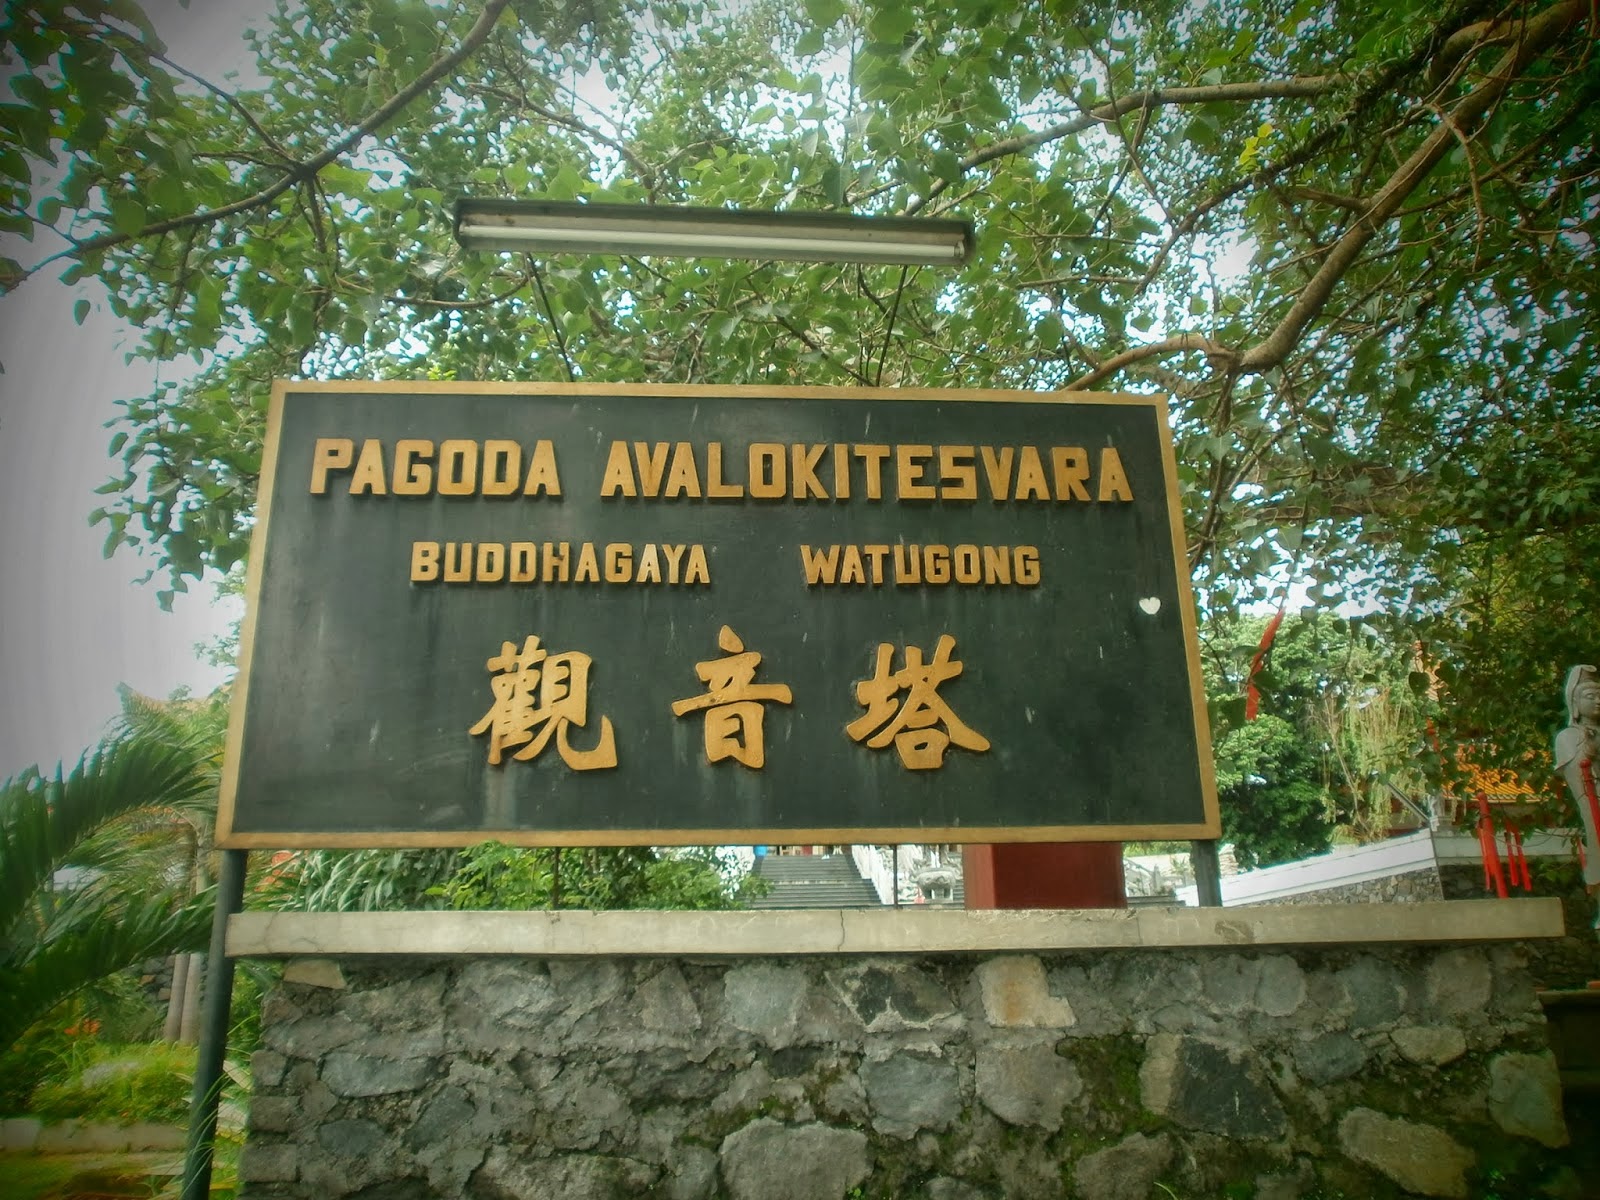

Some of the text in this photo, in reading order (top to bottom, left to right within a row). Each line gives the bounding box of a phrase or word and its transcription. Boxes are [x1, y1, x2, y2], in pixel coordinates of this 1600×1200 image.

[310, 438, 1134, 503] PAGODA AVALOKITESVARA
[410, 541, 1041, 586] BUDDHAGAYA WATUGONG
[469, 625, 991, 771] 觀音塔
